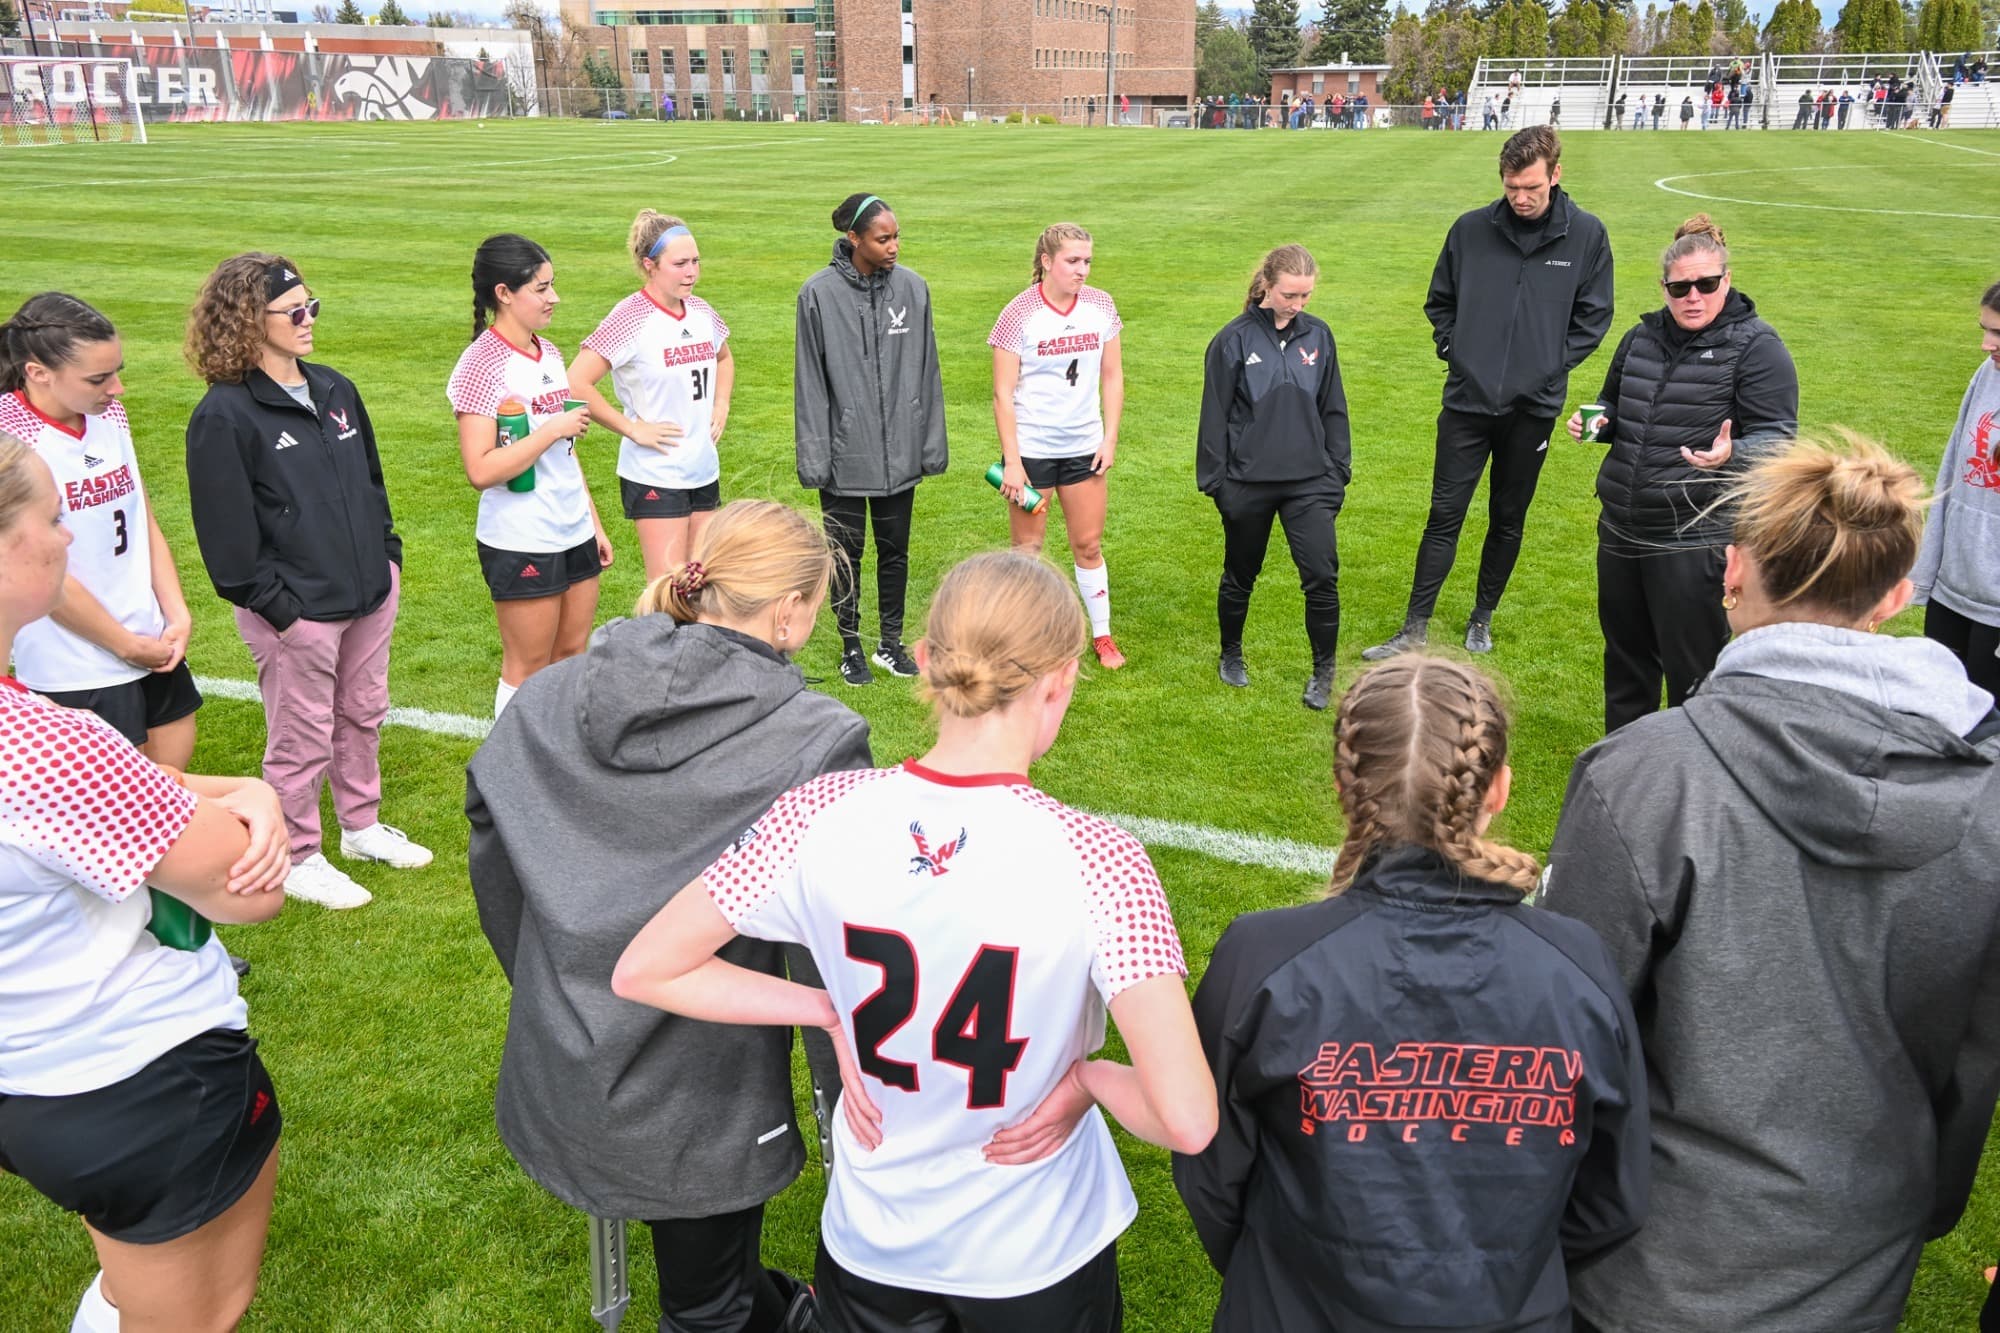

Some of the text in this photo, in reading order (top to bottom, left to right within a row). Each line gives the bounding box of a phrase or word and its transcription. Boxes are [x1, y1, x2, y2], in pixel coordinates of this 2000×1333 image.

[13, 63, 220, 104] SOCCER
[1037, 332, 1100, 350] EASTERN
[1037, 343, 1100, 356] WASHINGTON
[691, 367, 708, 401] 31
[1066, 358, 1079, 386] 4
[64, 463, 132, 500] EASTER
[113, 509, 128, 557] 3
[843, 921, 1030, 1109] 24
[1298, 1042, 1583, 1092] EASTERN
[1300, 1086, 1575, 1126] WASHINGTON
[1300, 1119, 1575, 1146] SOCCER
